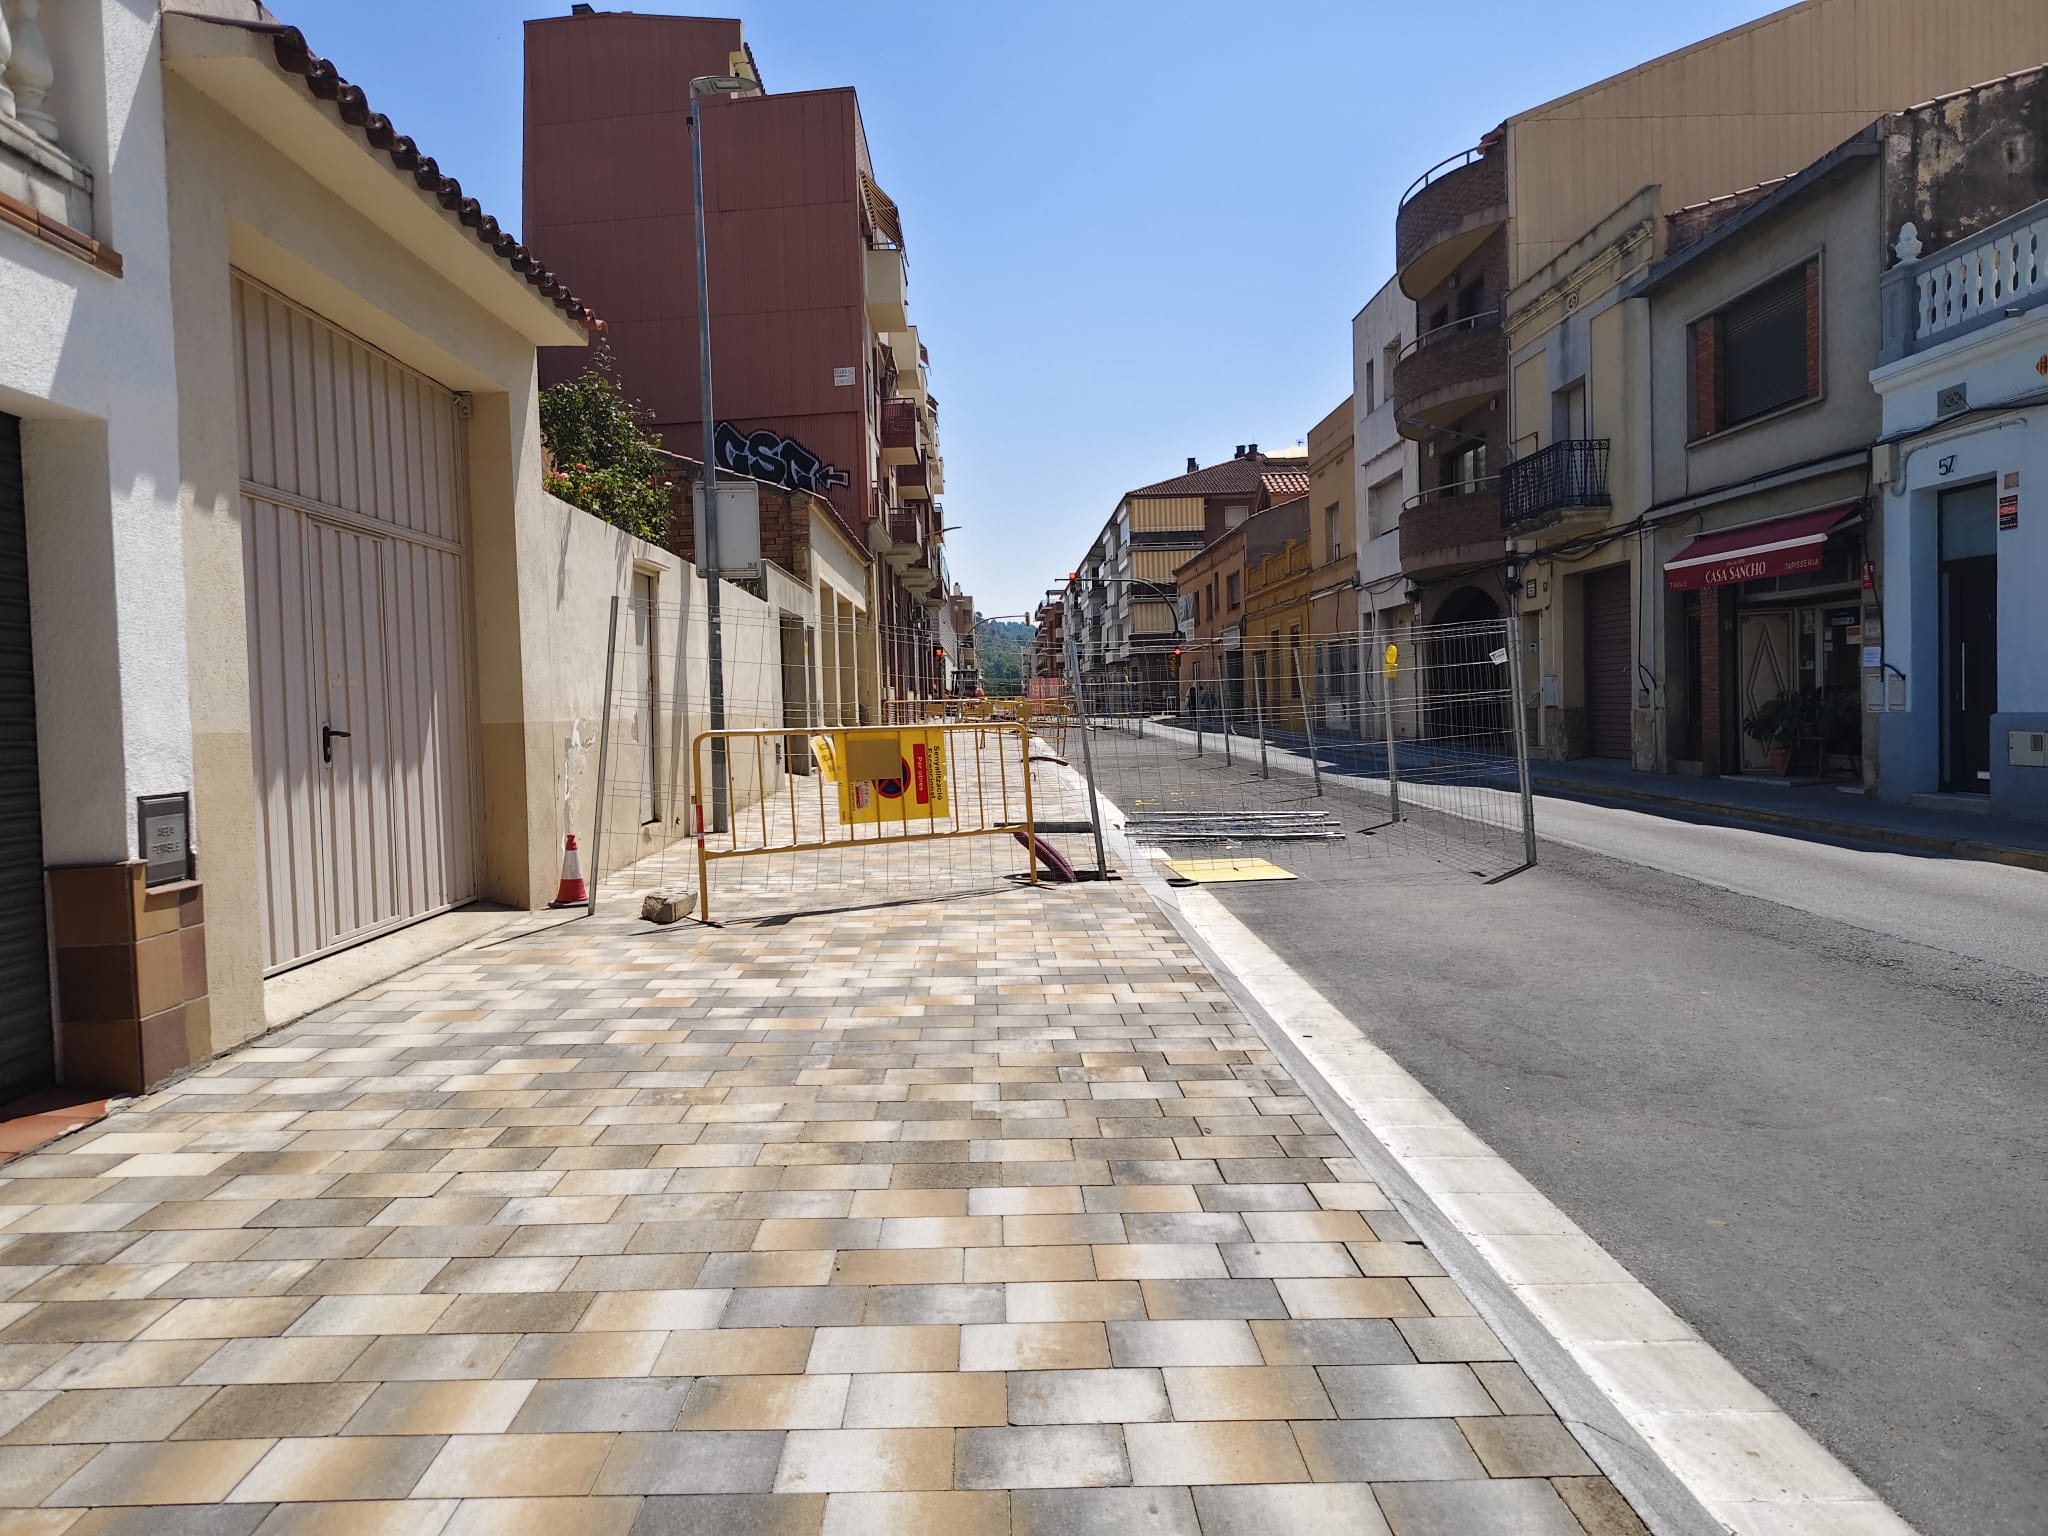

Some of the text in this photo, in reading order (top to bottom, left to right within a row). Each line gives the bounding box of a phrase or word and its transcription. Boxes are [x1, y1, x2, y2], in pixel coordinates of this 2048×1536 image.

[1938, 454, 1957, 476] 57
[1705, 569, 1728, 584] CASA
[1729, 561, 1766, 580] SANCHO
[933, 745, 944, 801] Senyalització
